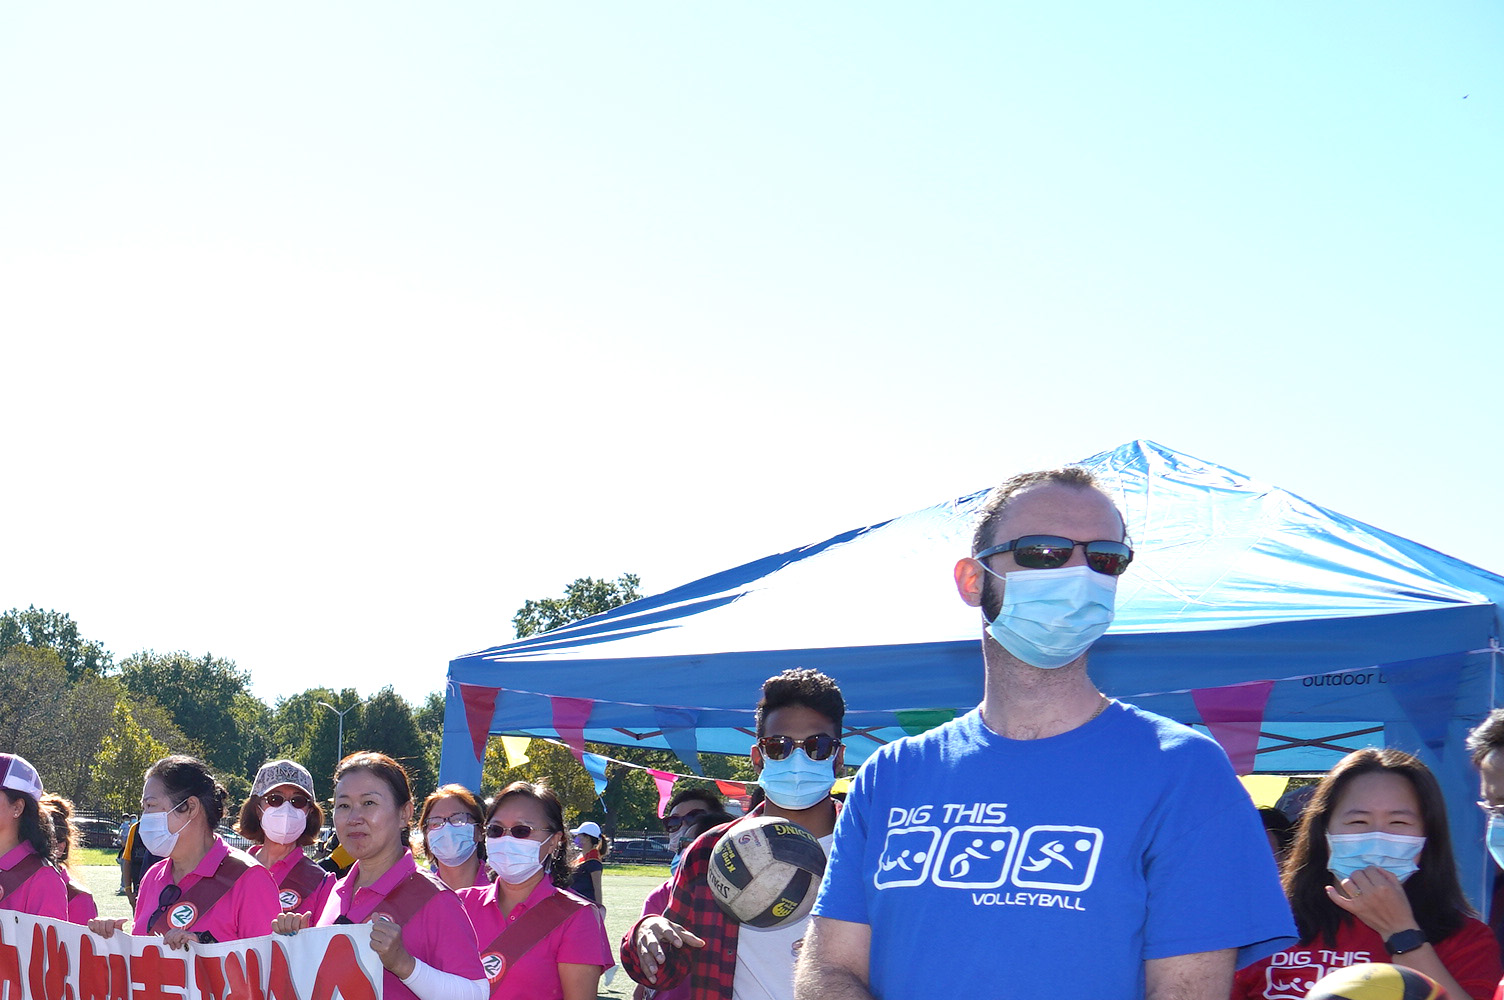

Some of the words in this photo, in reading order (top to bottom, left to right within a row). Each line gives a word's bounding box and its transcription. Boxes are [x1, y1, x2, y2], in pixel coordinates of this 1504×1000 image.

[1302, 672, 1374, 687] outdoor
[887, 804, 934, 828] DIG
[942, 802, 1008, 824] THIS
[971, 892, 1086, 911] VOLLEYBALL
[1270, 950, 1312, 966] DIG
[1318, 950, 1372, 967] THIS
